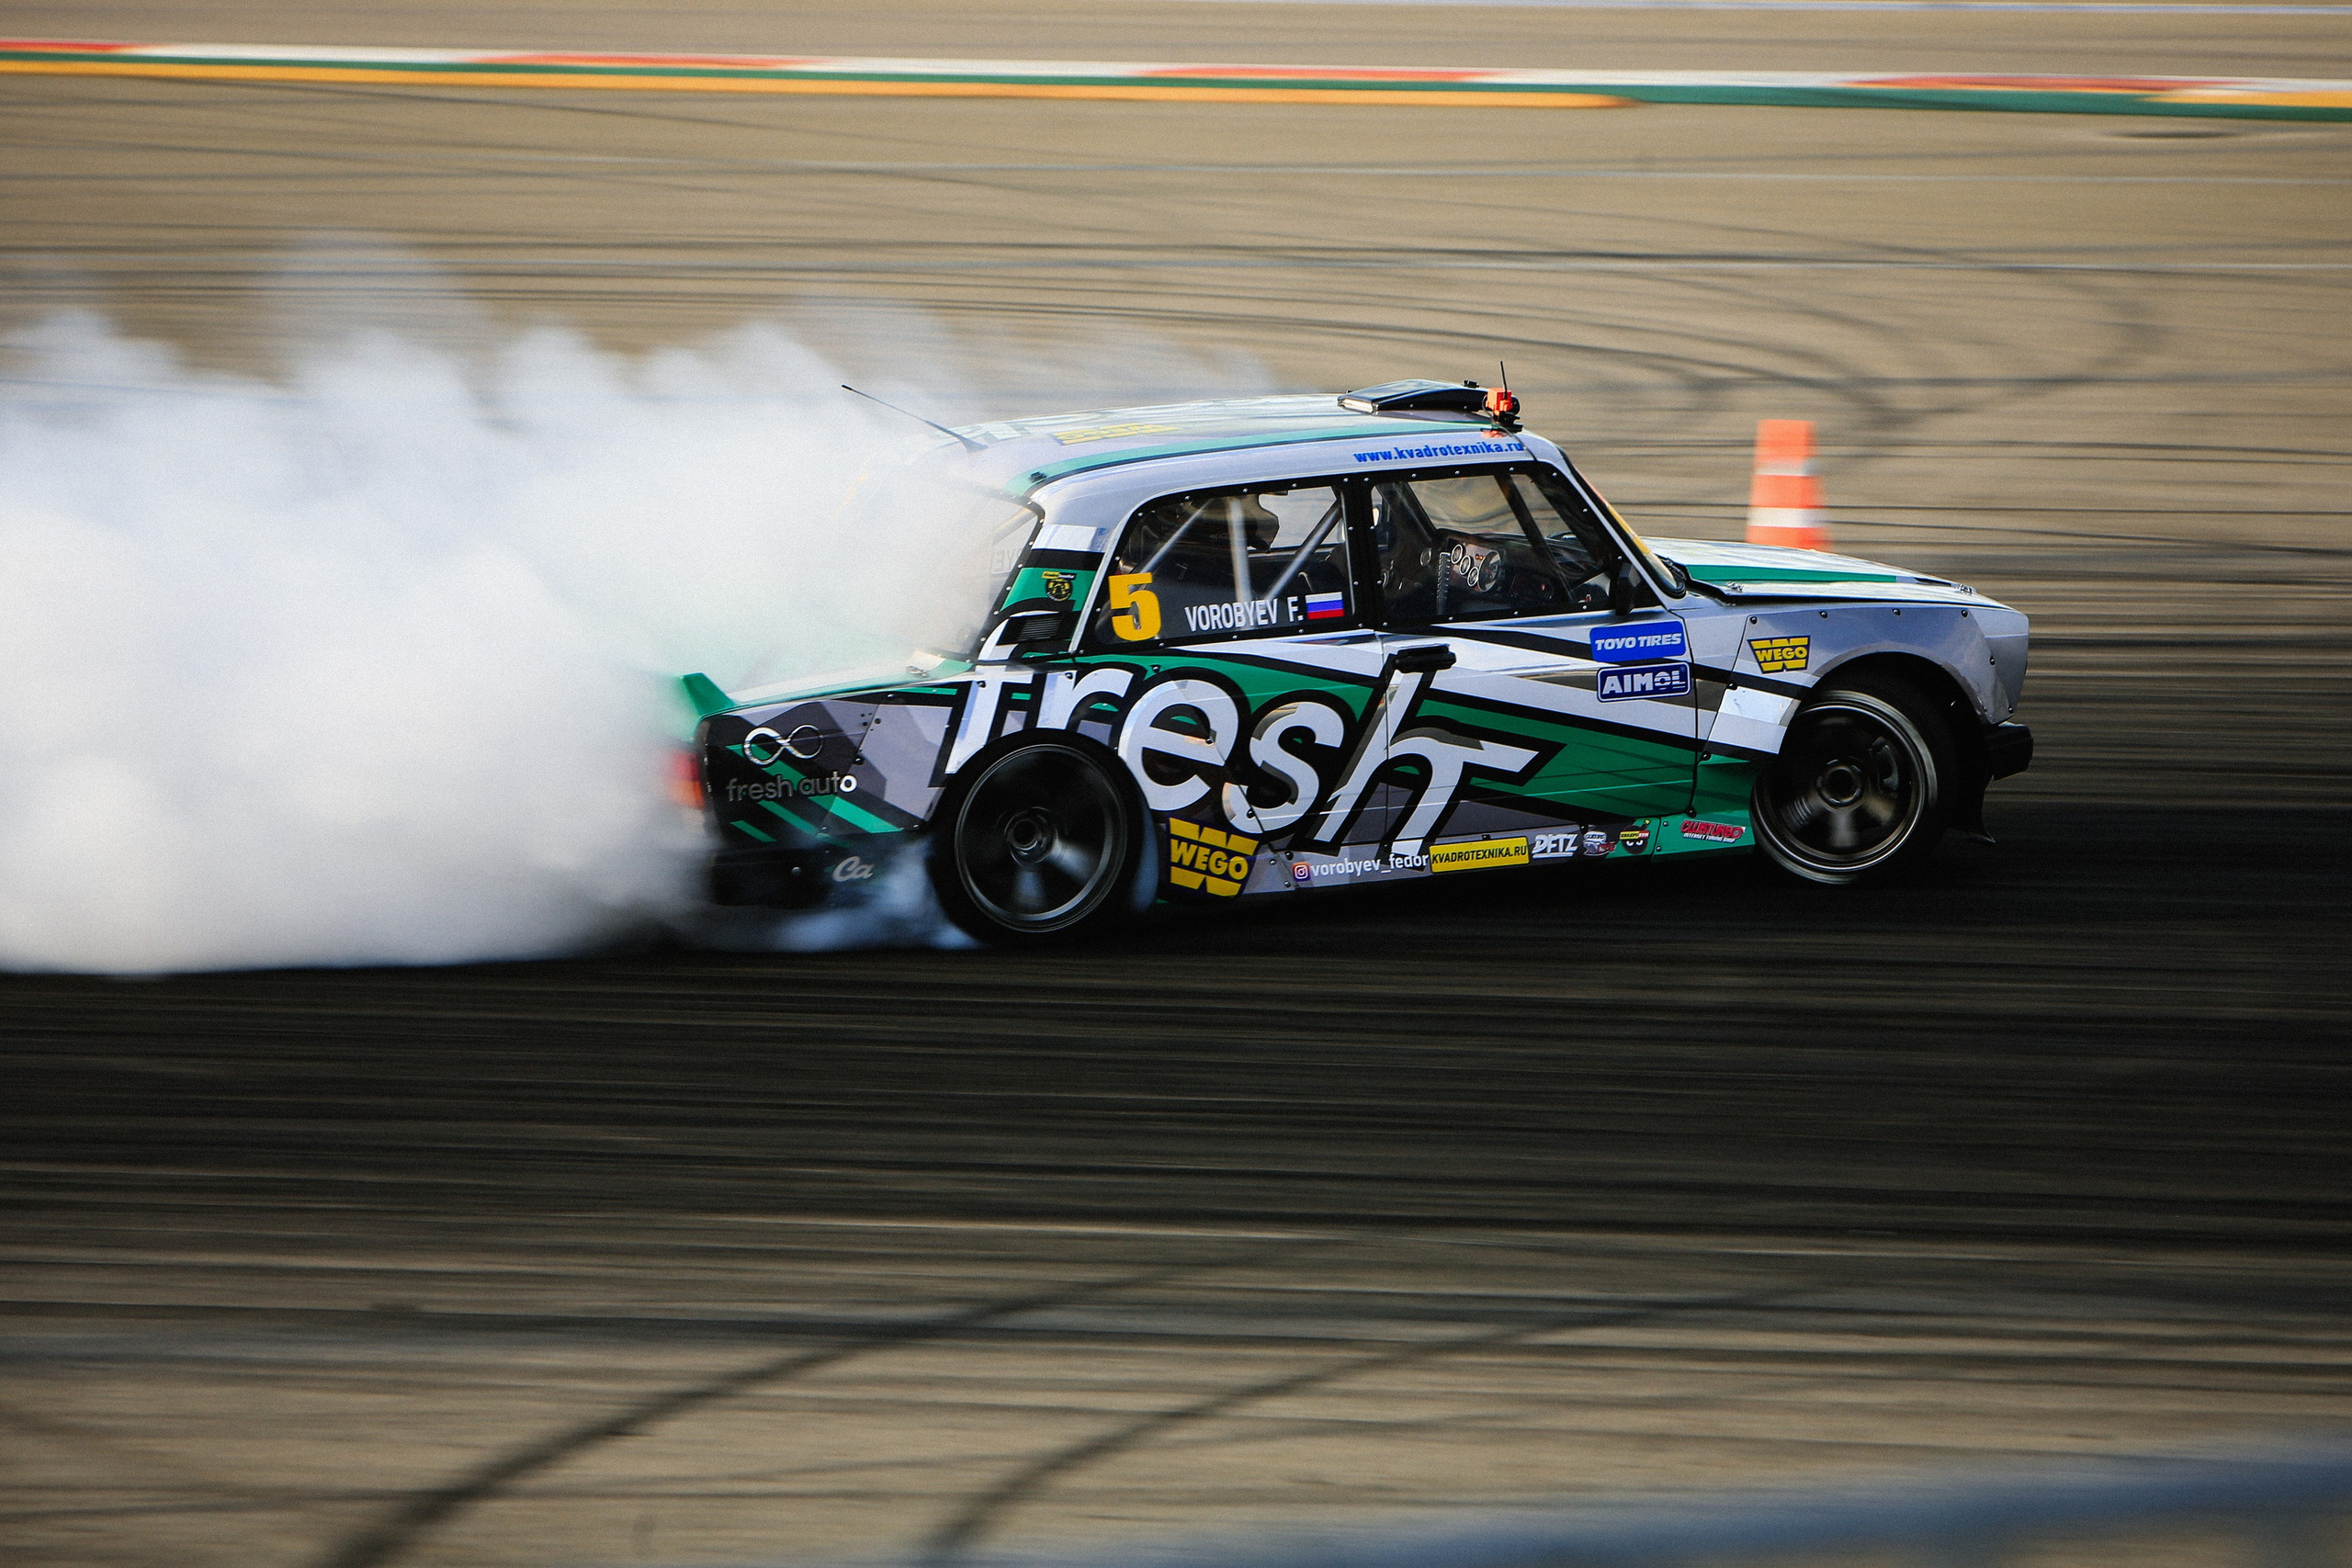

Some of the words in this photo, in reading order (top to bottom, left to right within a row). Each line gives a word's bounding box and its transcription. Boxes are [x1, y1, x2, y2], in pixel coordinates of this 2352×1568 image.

[1353, 441, 1524, 463] www.kvadrotexnika.ru
[1108, 572, 1161, 641] 5
[1184, 598, 1278, 632] VOROBYEV
[1287, 596, 1304, 622] F.
[1595, 637, 1635, 651] TOYO
[1638, 633, 1682, 648] TIRES
[1755, 647, 1808, 661] WEGO
[1601, 670, 1686, 695] AIMOL
[944, 609, 1538, 857] fresh
[727, 775, 793, 802] fresh
[799, 772, 857, 795] auto
[1170, 839, 1249, 880] WEGO
[1309, 853, 1430, 877] vorobyev_fedor
[1431, 844, 1527, 863] KVADROTEXNIKA.RU
